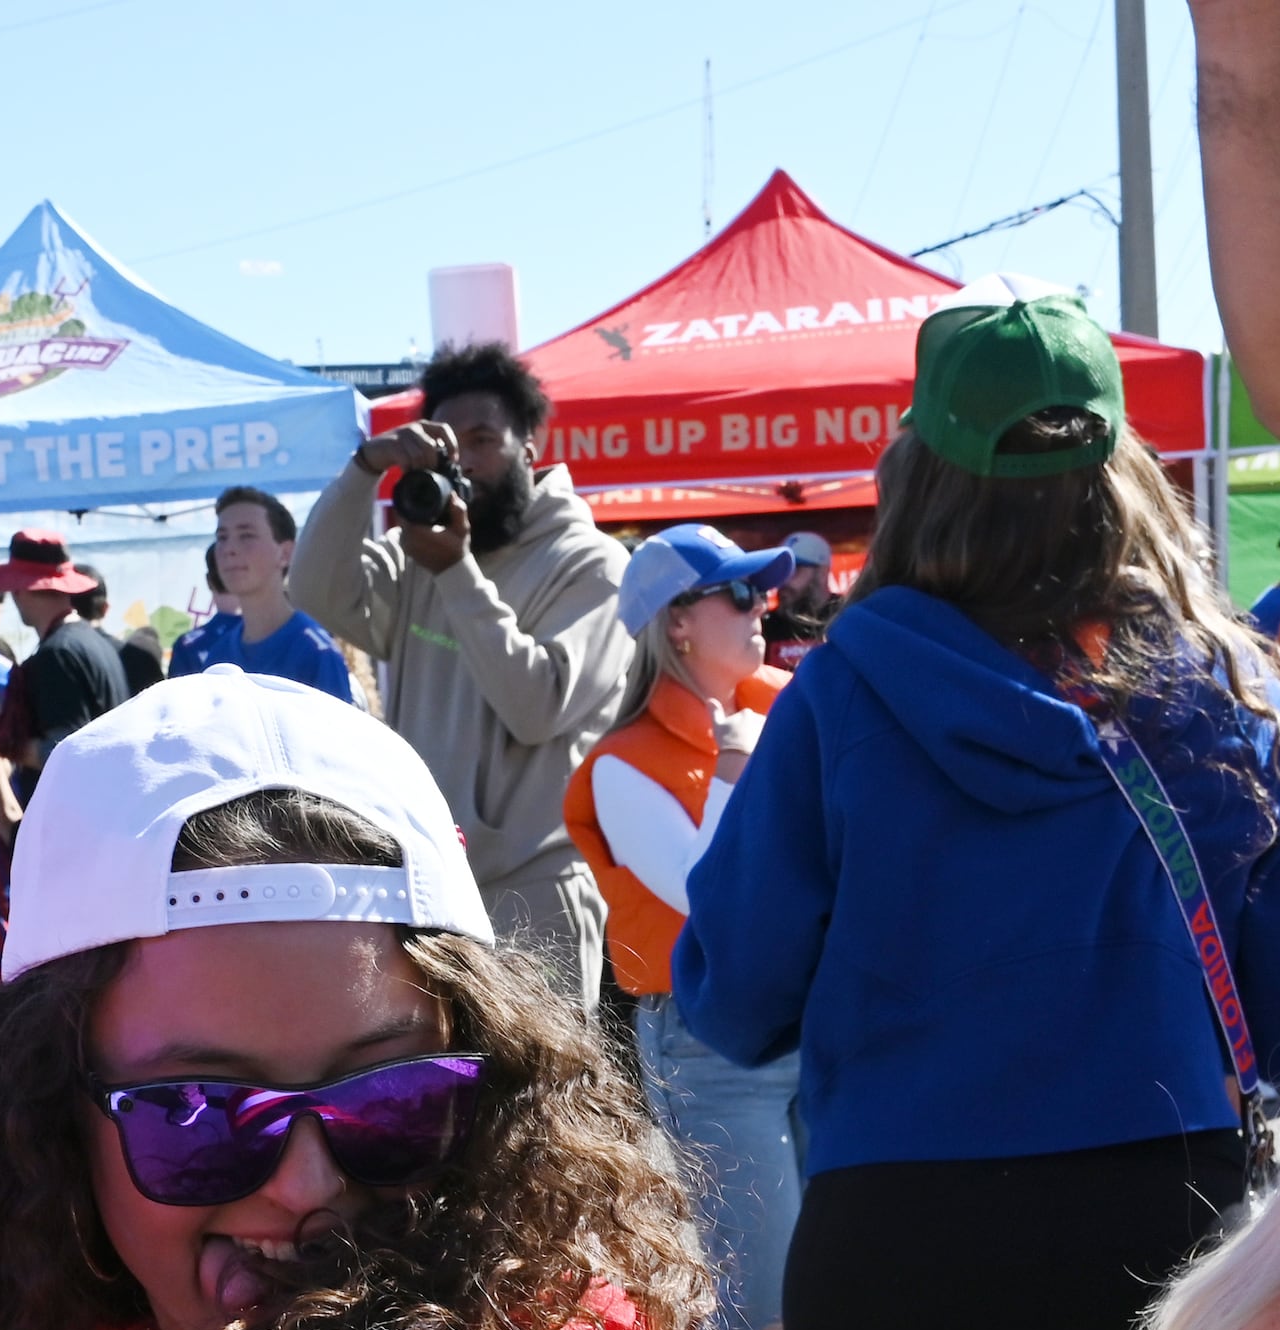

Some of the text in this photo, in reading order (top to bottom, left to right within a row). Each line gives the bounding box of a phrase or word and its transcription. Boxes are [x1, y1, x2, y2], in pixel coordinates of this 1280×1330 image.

[24, 431, 127, 483] THE
[138, 420, 290, 477] PREP.
[642, 417, 706, 457] UP
[1116, 757, 1254, 1073] FLORIDA GATORS
